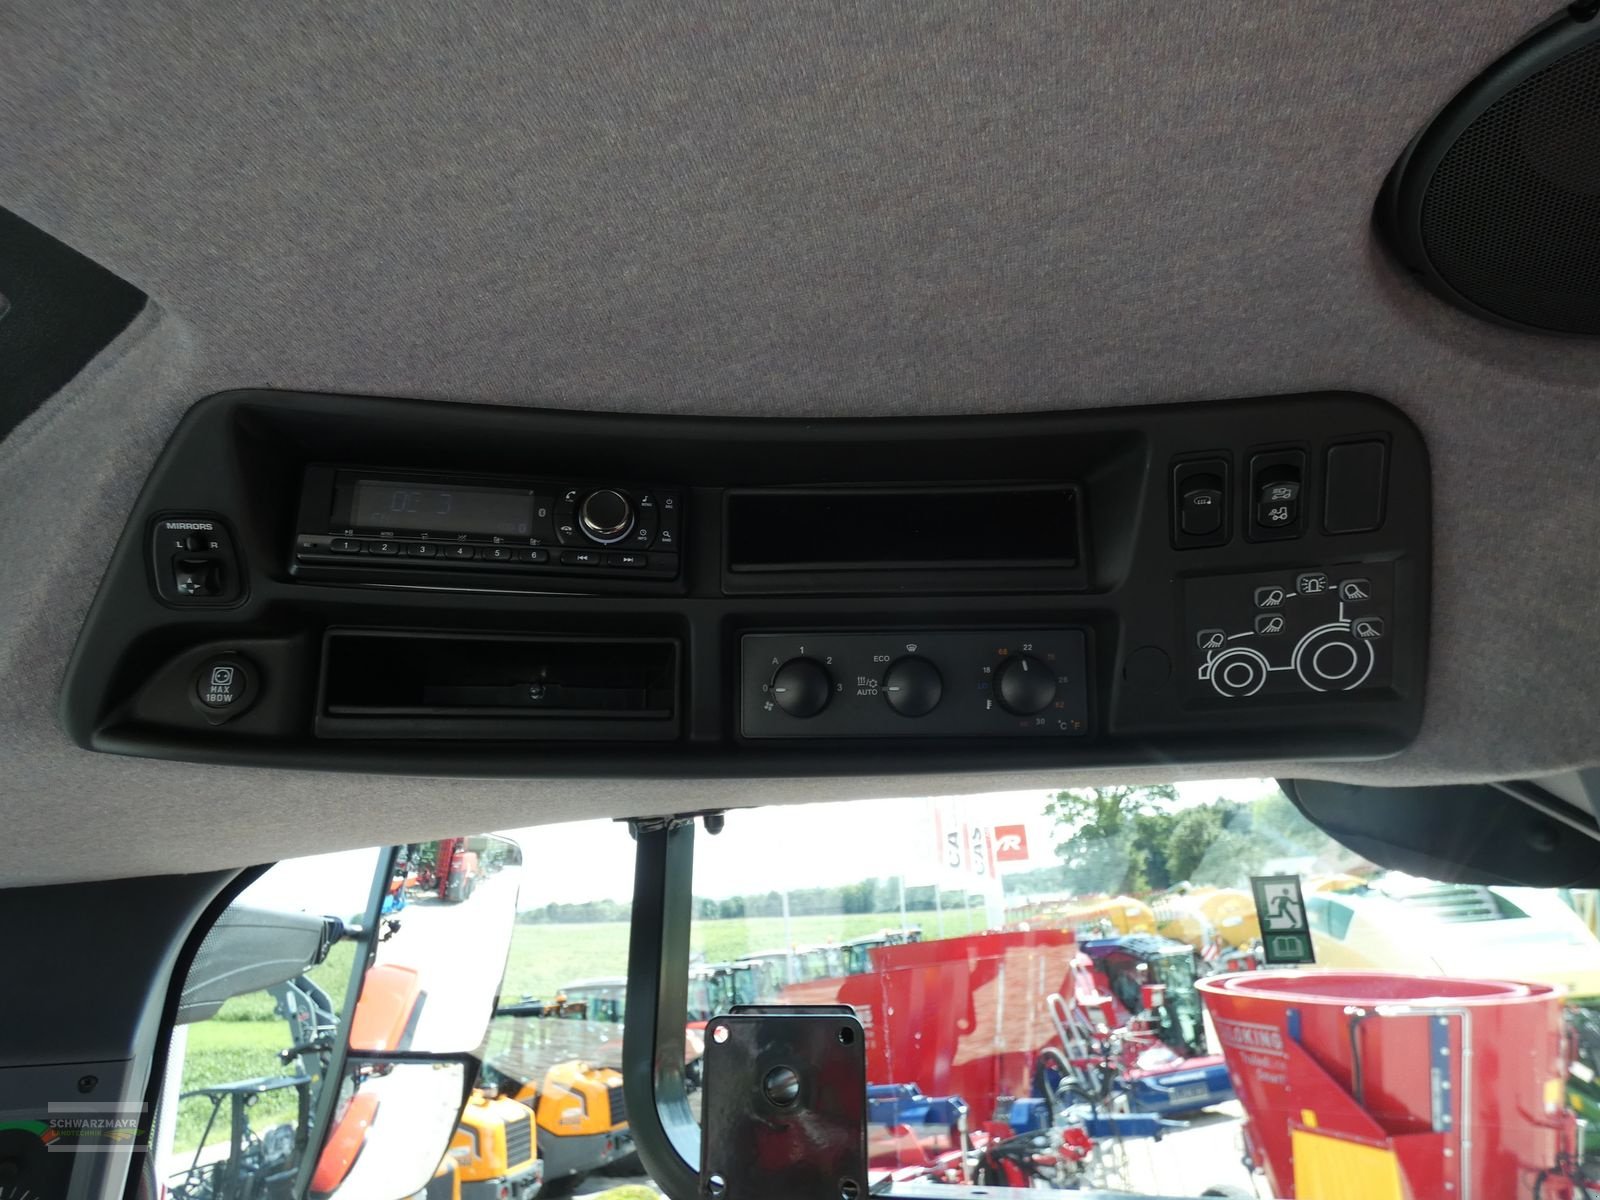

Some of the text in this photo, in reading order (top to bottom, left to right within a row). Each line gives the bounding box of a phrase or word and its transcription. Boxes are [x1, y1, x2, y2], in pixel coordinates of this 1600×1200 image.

[166, 522, 214, 531] MIRRORS
[381, 543, 388, 551] 2
[419, 545, 426, 553] 3
[494, 549, 501, 557] 5
[531, 551, 537, 559] 6
[799, 646, 805, 654] 1
[1023, 643, 1033, 651] 22
[771, 657, 779, 665] A
[826, 656, 833, 665] 2
[210, 686, 230, 694] MAX
[762, 684, 769, 692] 0
[836, 683, 843, 692] 3
[206, 694, 233, 702] 180W
[1035, 718, 1046, 726] 30
